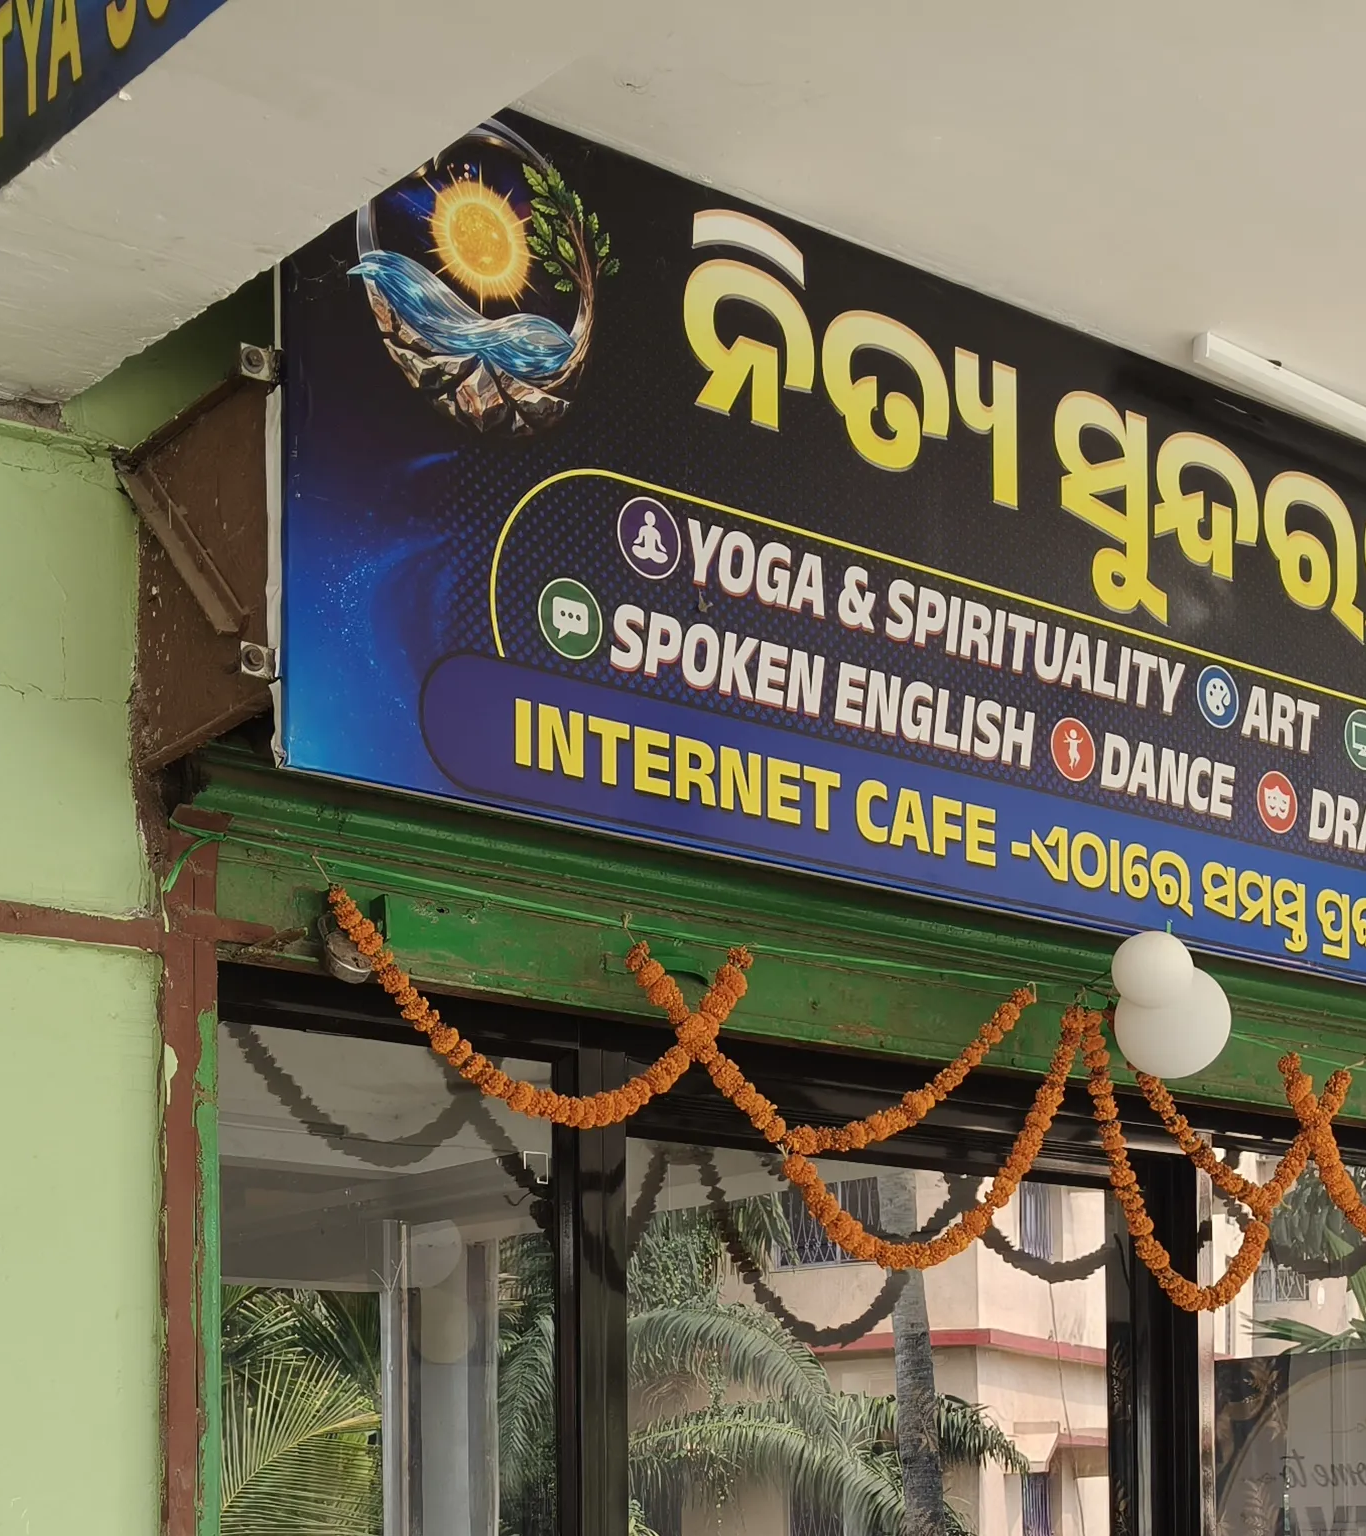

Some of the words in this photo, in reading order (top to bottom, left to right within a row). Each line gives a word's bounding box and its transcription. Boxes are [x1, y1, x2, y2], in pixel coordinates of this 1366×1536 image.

[683, 207, 1019, 511] ନିତ୍ୟ
[610, 603, 825, 717] SPOKEN
[835, 661, 1035, 771] ENGLISH
[1100, 730, 1235, 821] DANCE
[688, 518, 826, 619] YOGA
[838, 566, 876, 631] &
[886, 577, 1185, 715] SPIRITUALITY
[1241, 685, 1320, 754] ART
[514, 697, 841, 833] INTERNET
[855, 779, 997, 868] CAFE
